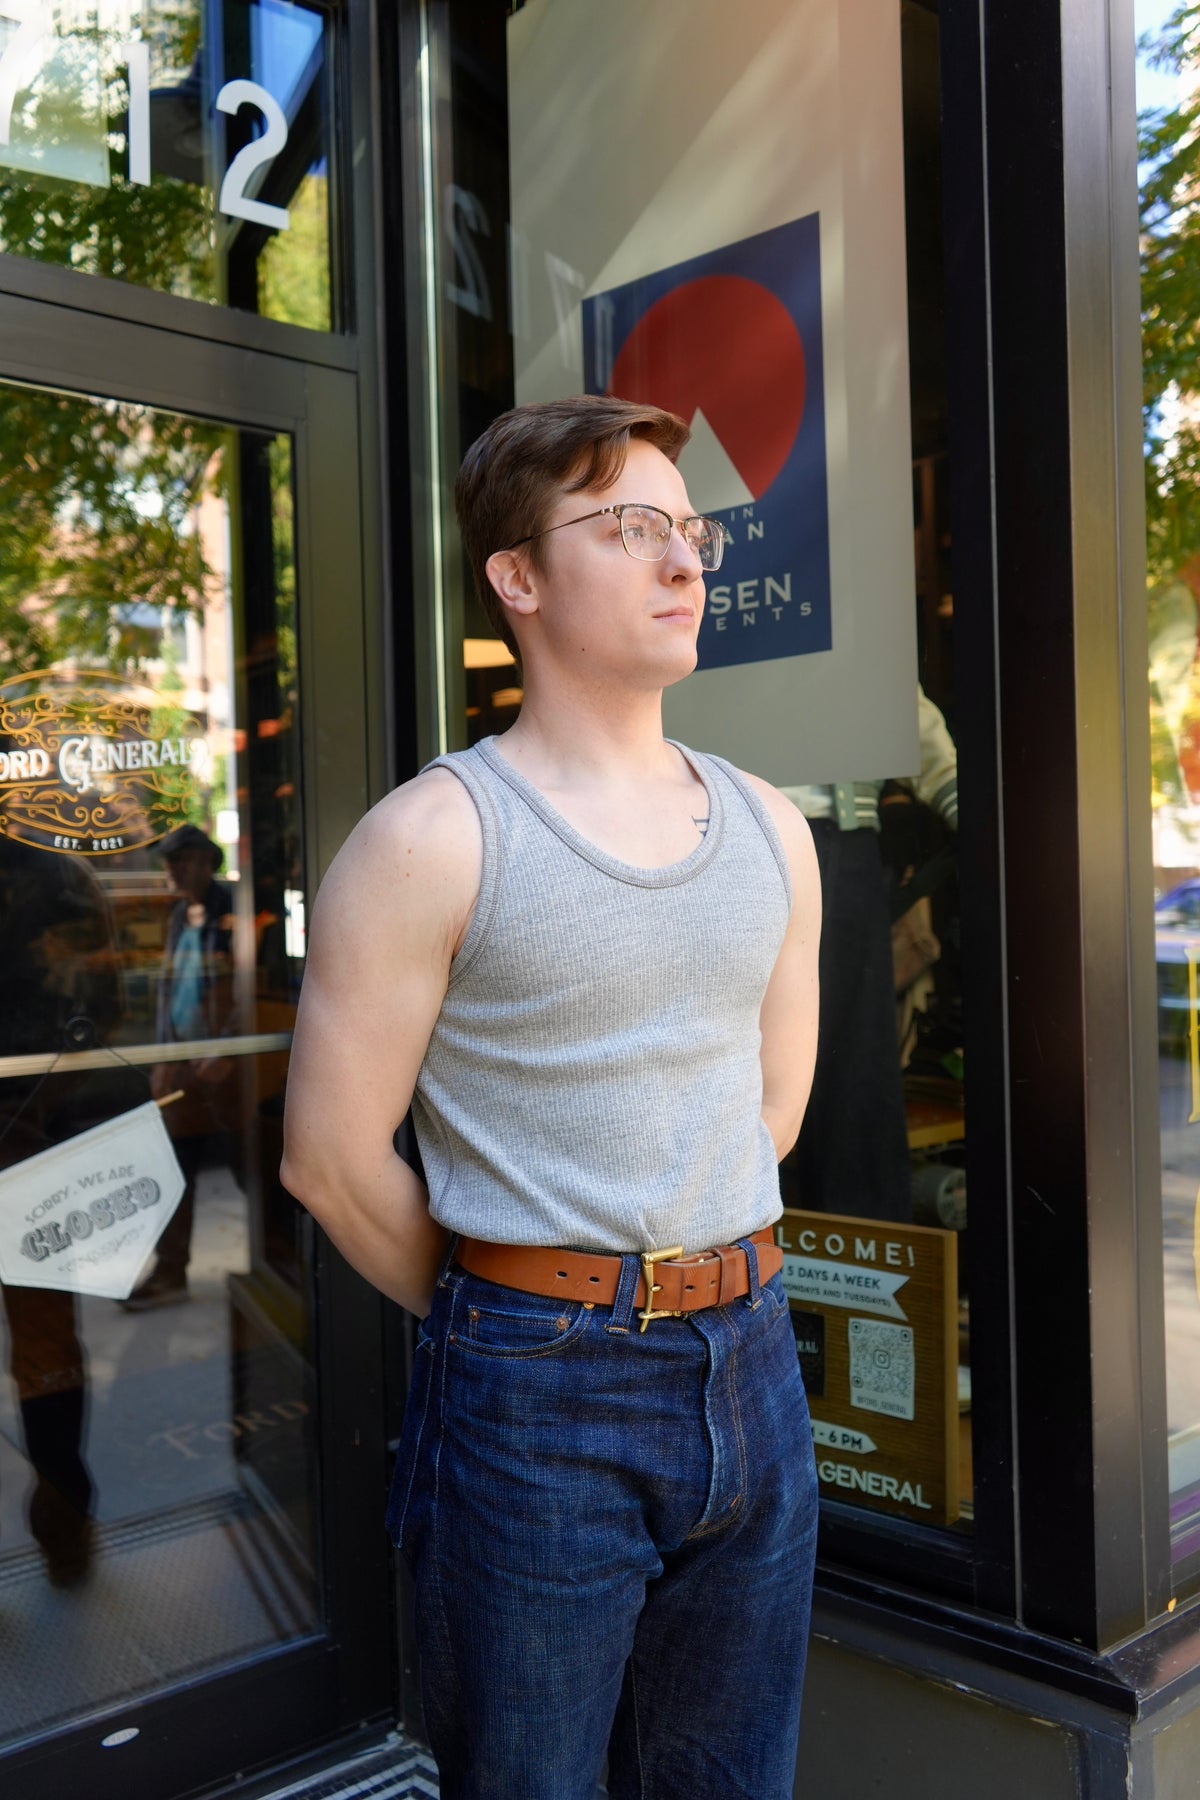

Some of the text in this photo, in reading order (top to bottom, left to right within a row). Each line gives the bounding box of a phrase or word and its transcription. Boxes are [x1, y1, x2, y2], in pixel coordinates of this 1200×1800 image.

[709, 573, 792, 615] SEN
[715, 602, 812, 631] ENTS
[0, 736, 194, 793] ORD GENERAL
[53, 835, 125, 851] EST. 2021
[77, 1171, 105, 1190] WE
[108, 1164, 136, 1181] ARE
[20, 1176, 161, 1263] CLOSED
[777, 1226, 915, 1268] LCOME!
[787, 1265, 795, 1277] 5
[798, 1267, 829, 1282] DAYS
[832, 1272, 841, 1284] A
[844, 1274, 881, 1290] WEEK
[823, 1289, 841, 1299] AND
[828, 1429, 837, 1443] 6
[841, 1433, 863, 1450] PM
[818, 1460, 933, 1510] GENERAL
